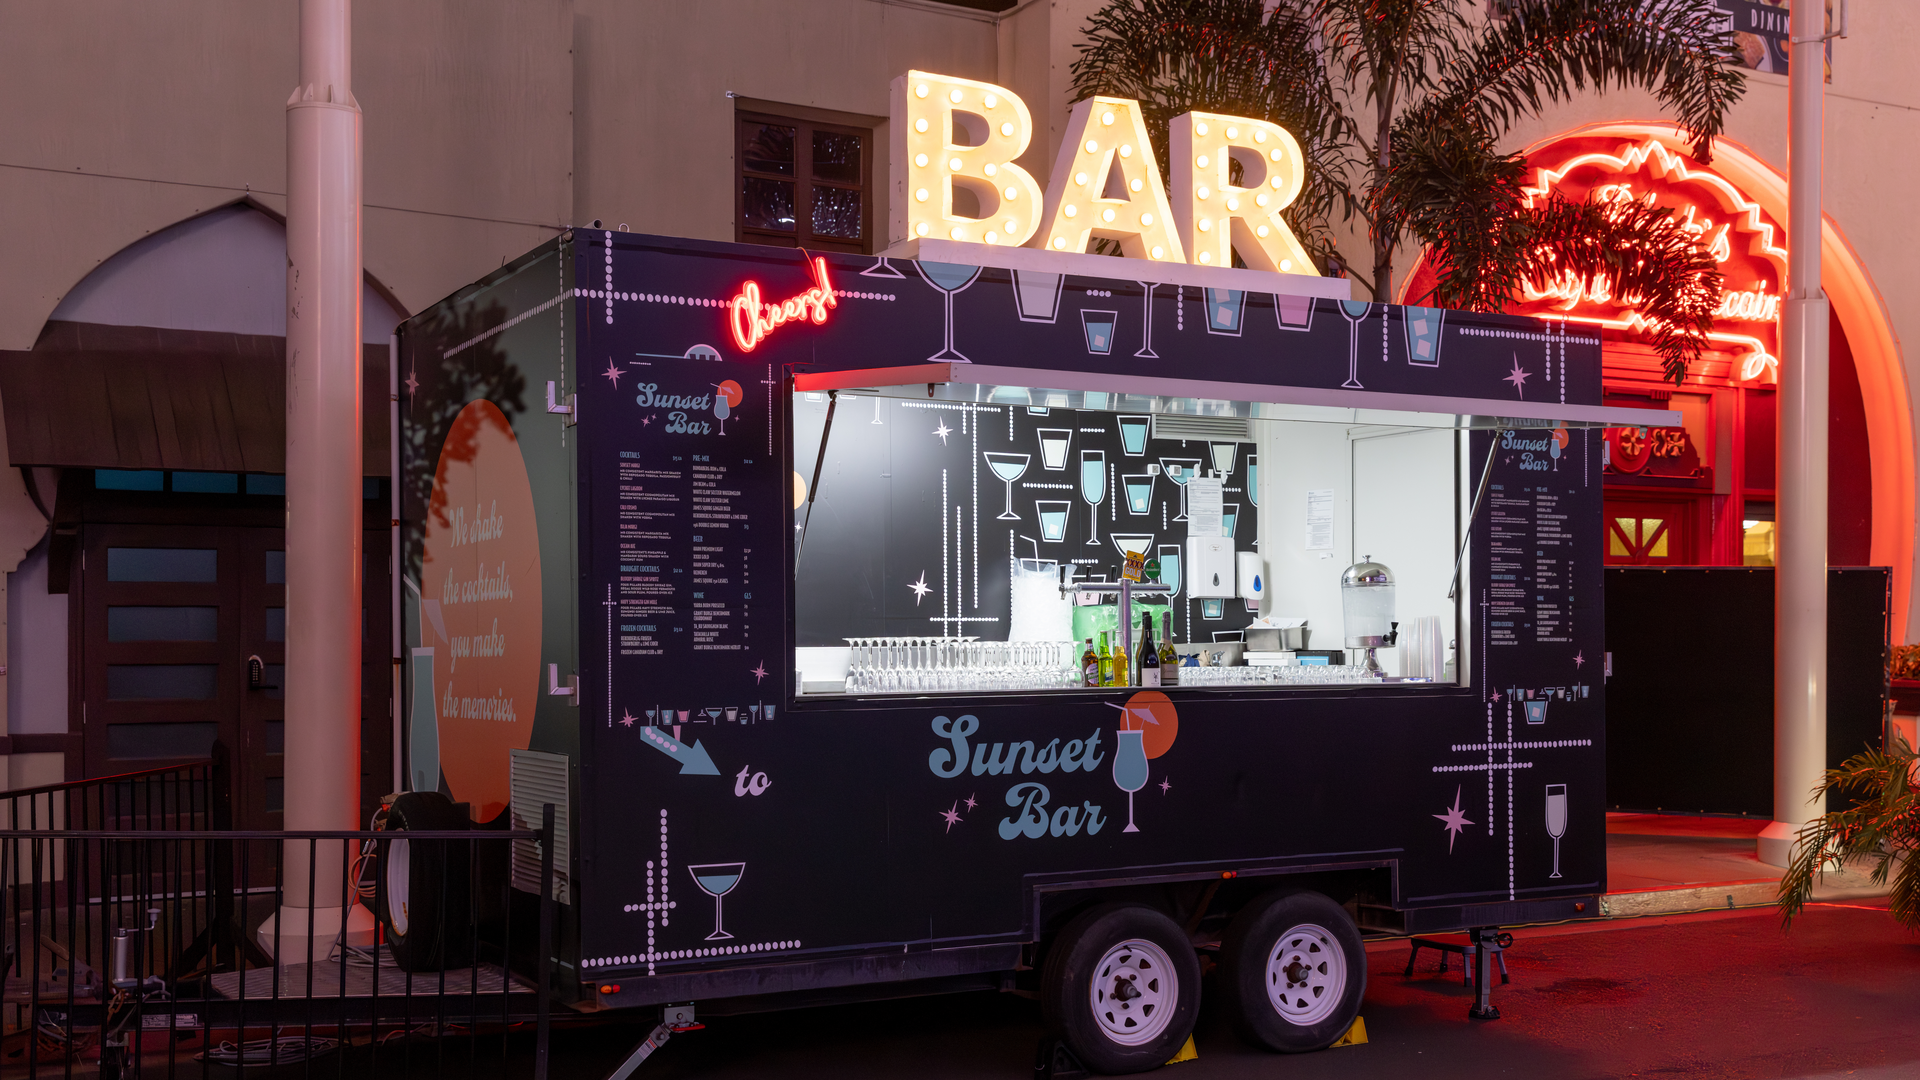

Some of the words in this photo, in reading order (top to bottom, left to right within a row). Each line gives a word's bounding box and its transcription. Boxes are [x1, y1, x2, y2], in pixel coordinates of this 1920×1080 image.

[1751, 8, 1790, 34] DININ
[892, 69, 1322, 277] BAR
[730, 256, 837, 352] Cheers!
[636, 382, 711, 410] Sunset
[665, 411, 712, 435] Bar
[1501, 430, 1549, 452] Sunset
[1519, 452, 1549, 471] Bar
[450, 506, 468, 548] We
[470, 499, 505, 544] shake
[443, 568, 459, 605] the
[461, 561, 513, 605] cocktails,
[1125, 566, 1141, 577] GOLD
[451, 632, 471, 674] you
[473, 617, 506, 657] make
[443, 681, 459, 718] the
[461, 687, 517, 723] memories.
[929, 714, 1105, 779] Sunset
[734, 764, 772, 797] to
[998, 782, 1107, 841] Bar
